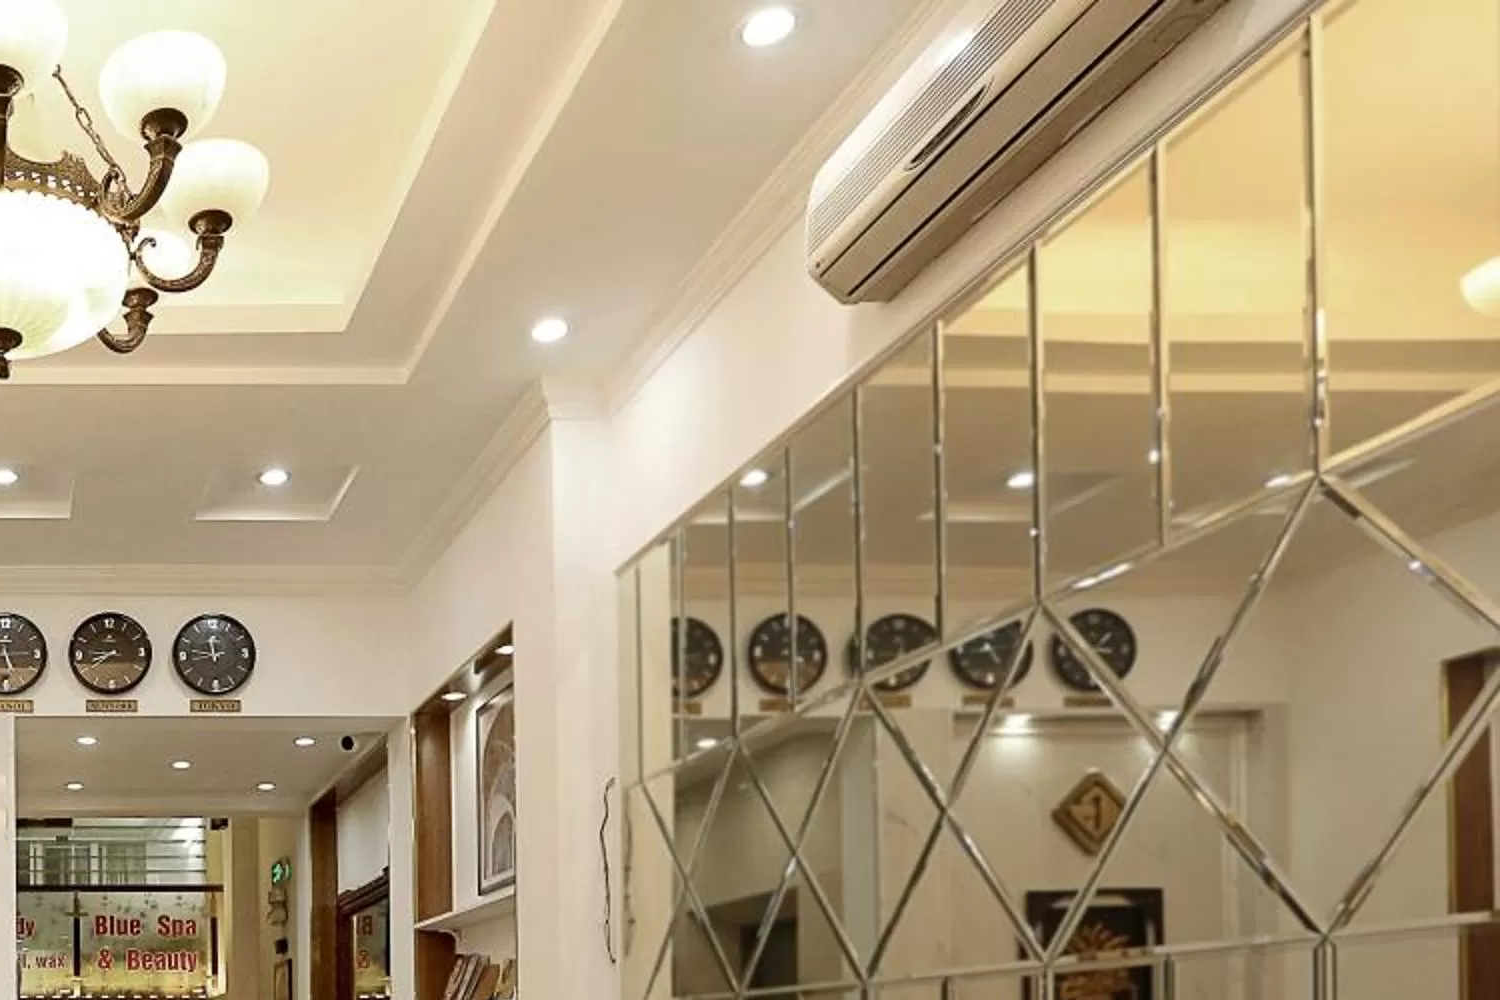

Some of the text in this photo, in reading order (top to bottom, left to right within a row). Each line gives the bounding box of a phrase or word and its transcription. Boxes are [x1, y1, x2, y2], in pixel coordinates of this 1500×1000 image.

[95, 915, 197, 937] Blue Spa
[35, 953, 67, 969] wax
[98, 948, 197, 972] & Beauty
